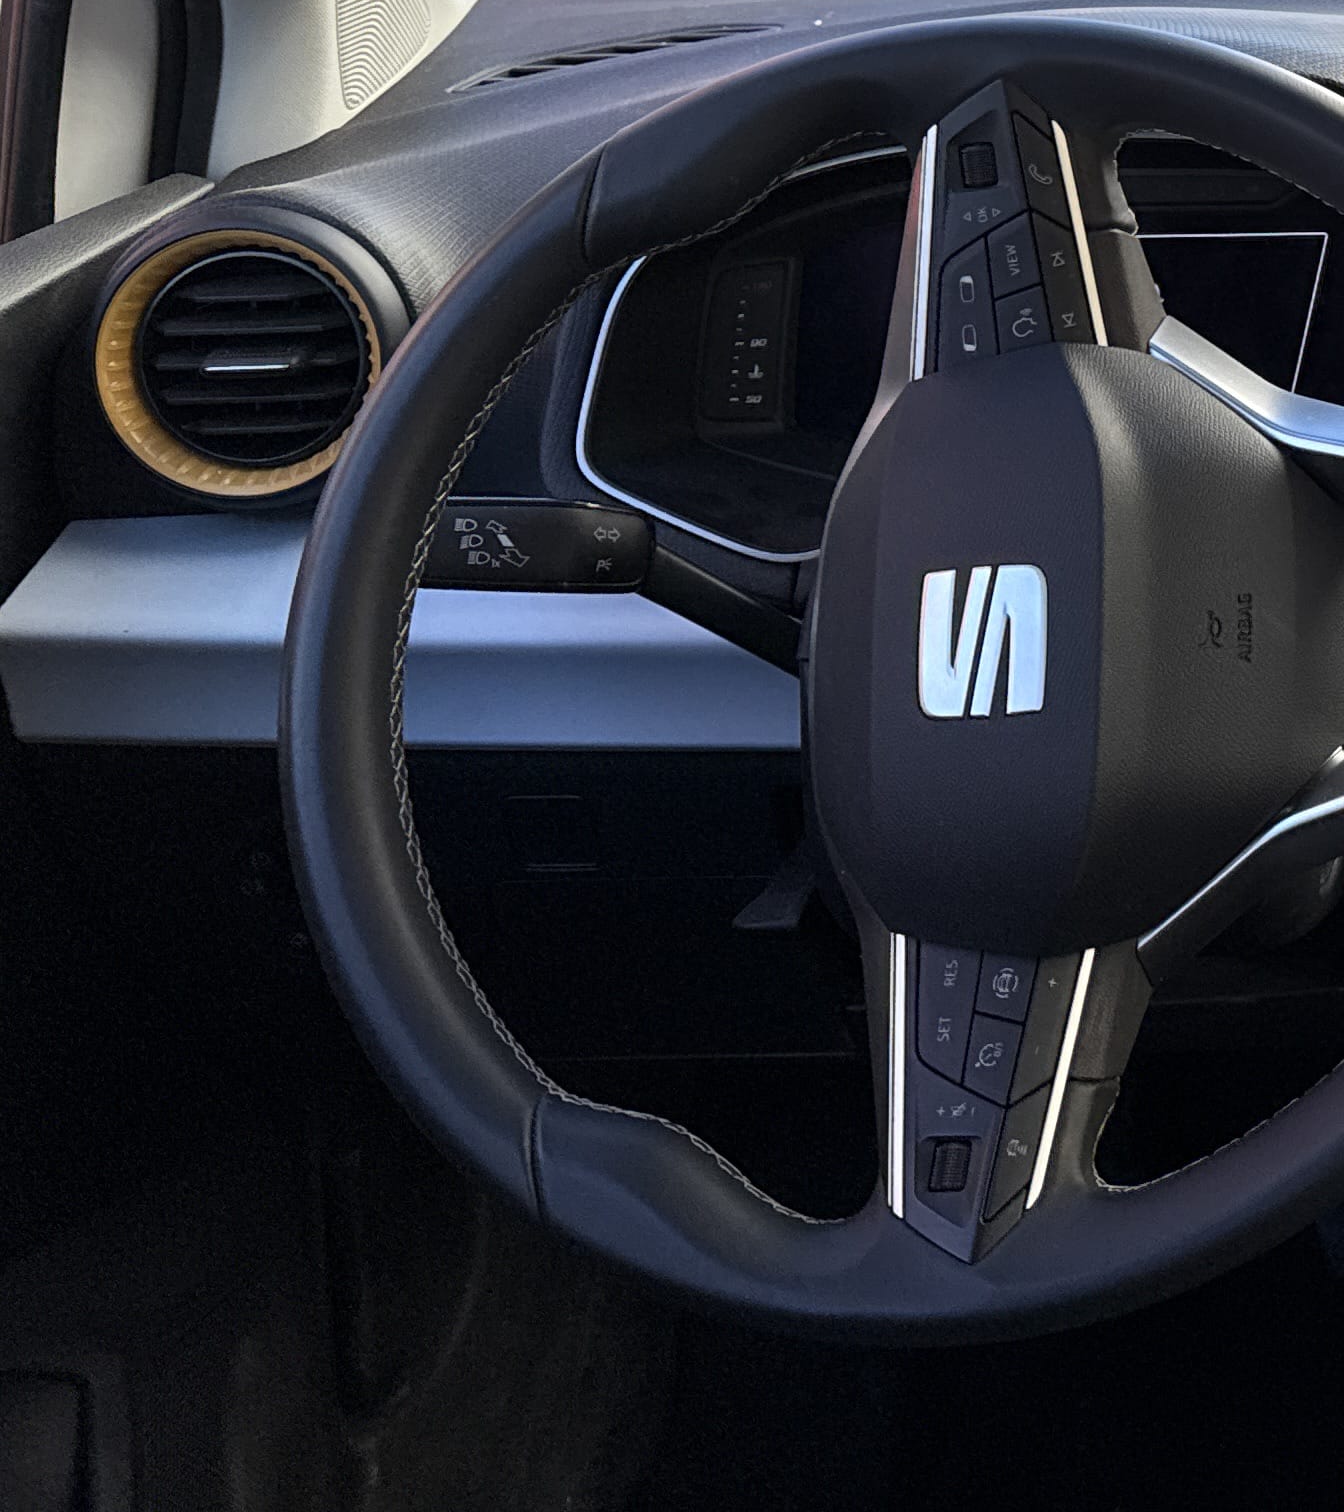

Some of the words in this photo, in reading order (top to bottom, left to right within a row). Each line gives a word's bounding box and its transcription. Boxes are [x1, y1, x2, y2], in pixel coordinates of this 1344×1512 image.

[977, 206, 989, 222] OK
[1006, 244, 1021, 276] VIEW
[1237, 592, 1253, 663] AIRBAG
[943, 959, 959, 987] RES
[937, 1017, 951, 1042] SET
